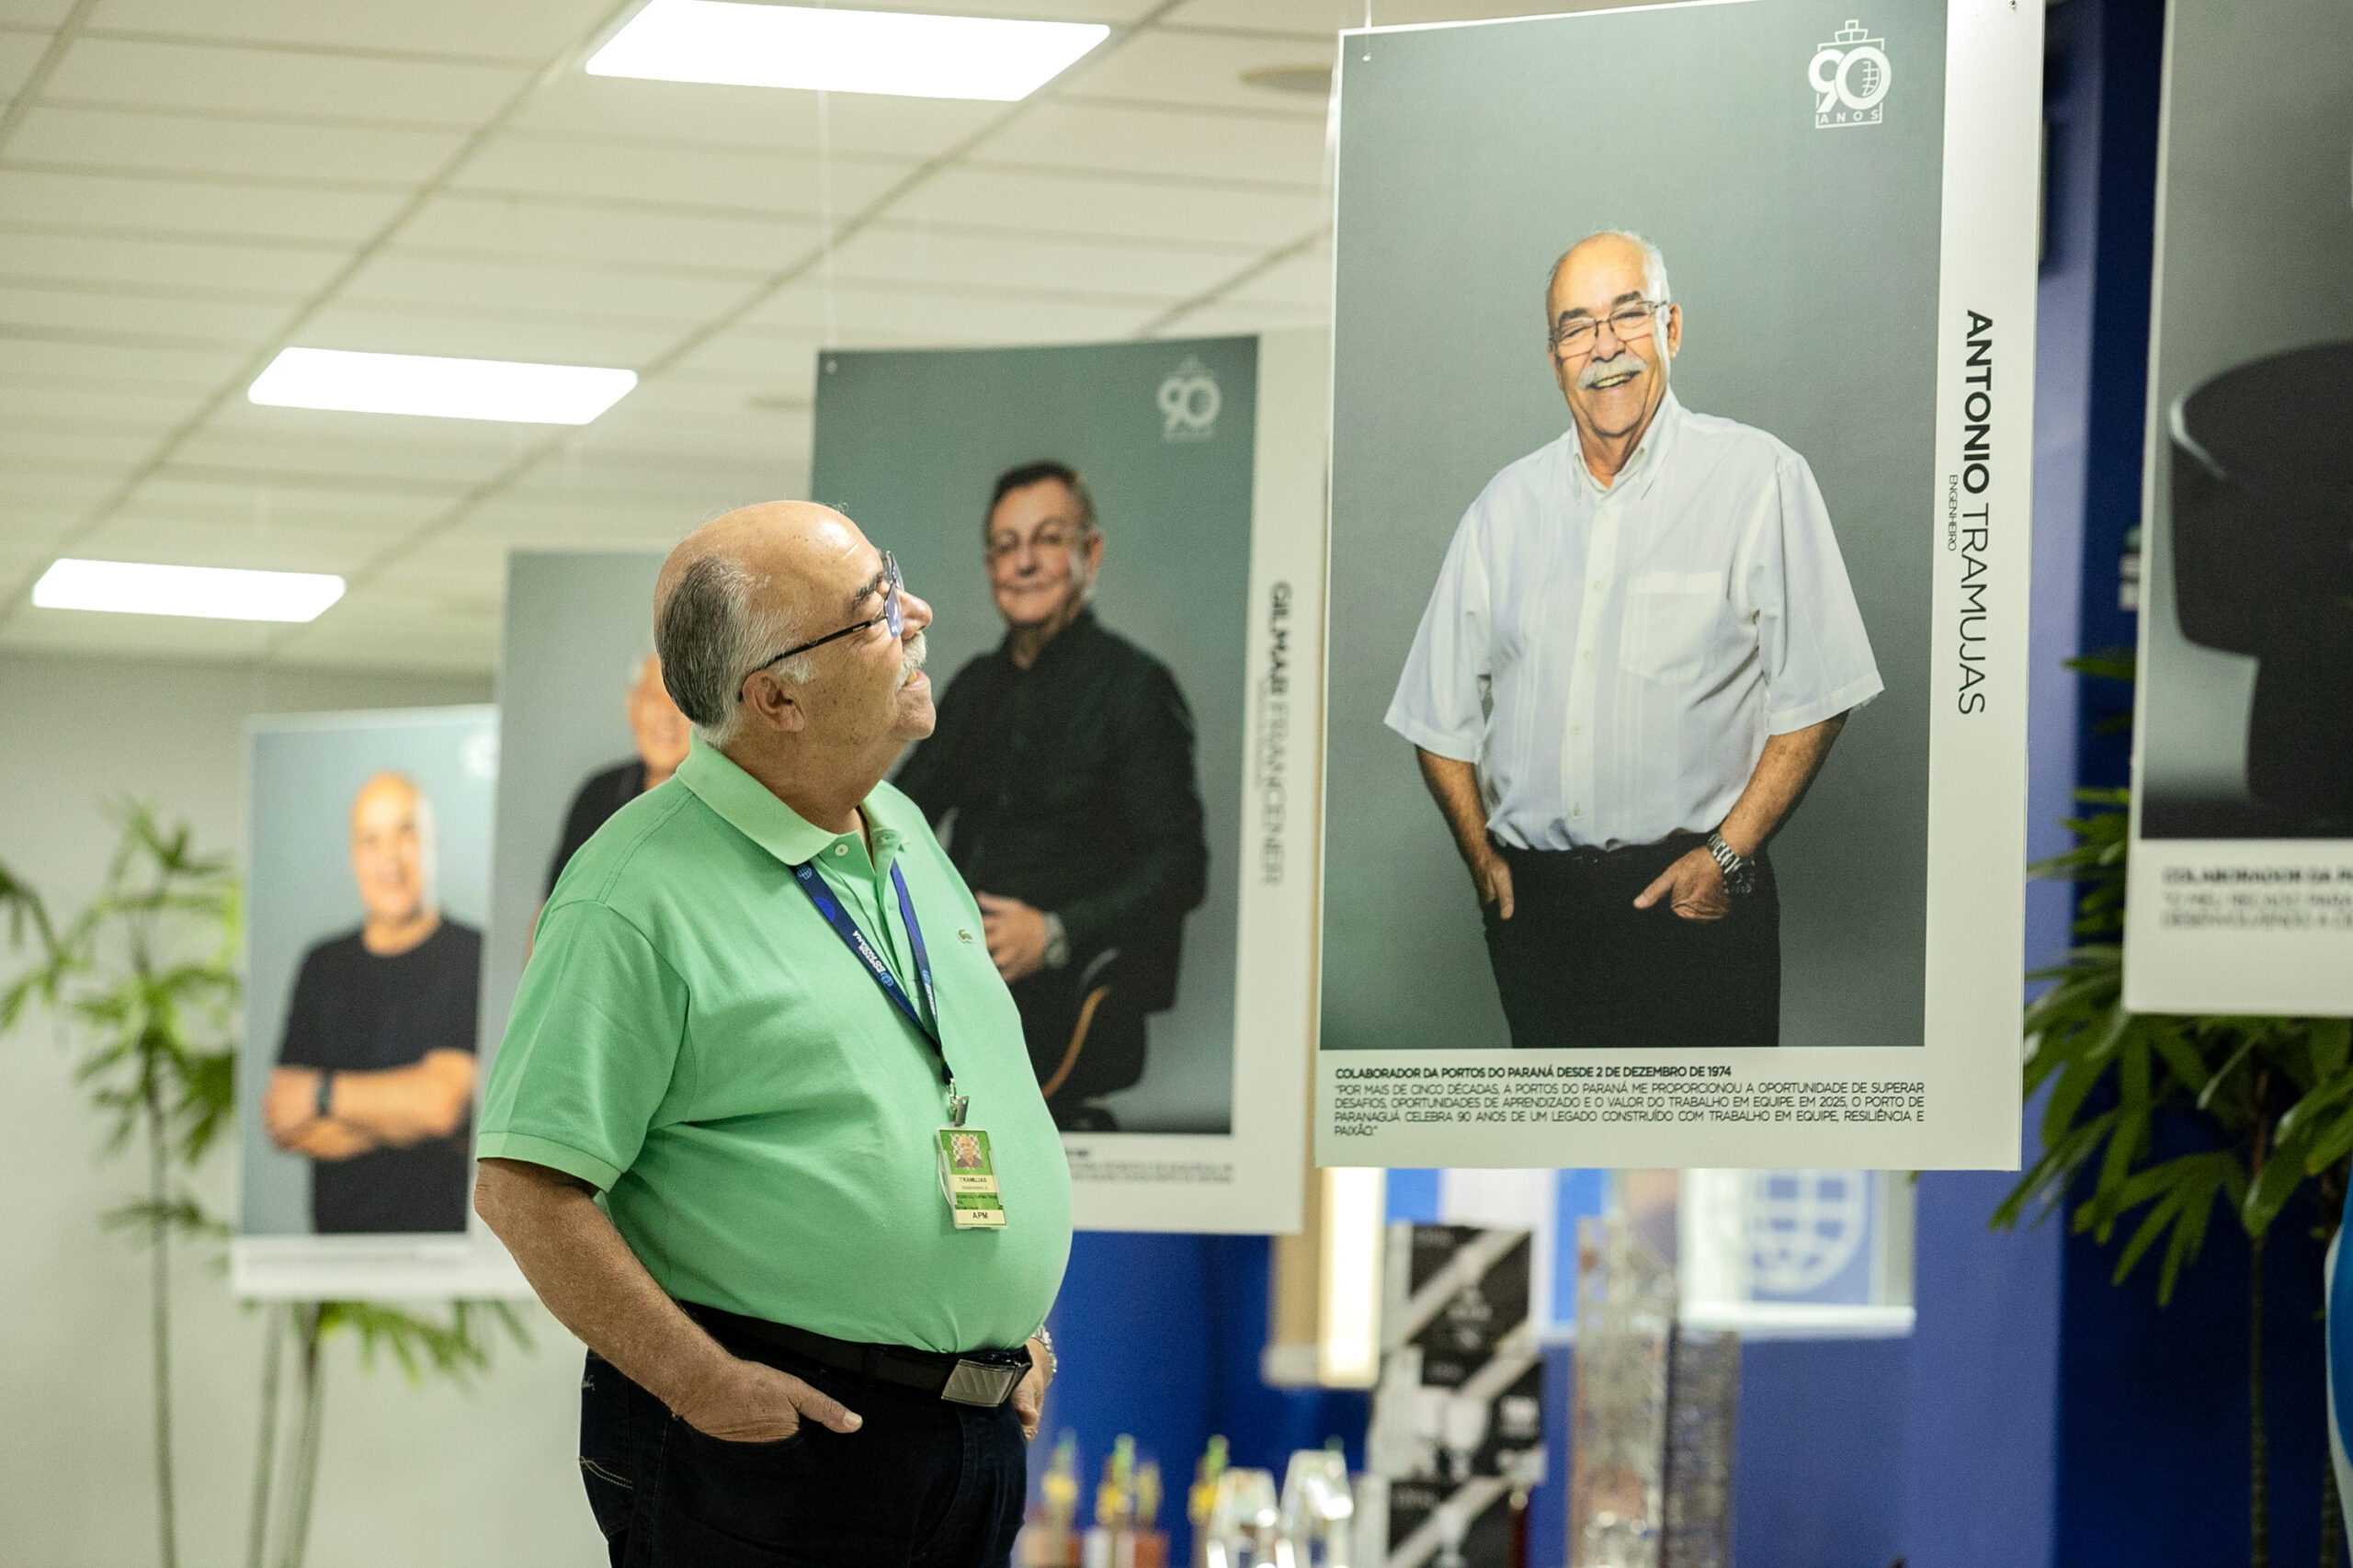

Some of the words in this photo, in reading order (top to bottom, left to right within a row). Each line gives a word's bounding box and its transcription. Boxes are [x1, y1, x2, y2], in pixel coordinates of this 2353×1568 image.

[1808, 46, 1892, 113] 90
[1819, 109, 1880, 124] ANOS
[1962, 309, 1994, 494] ANTONIO
[1948, 474, 1959, 551] ENGENHEIRO
[1958, 502, 1989, 715] TRAMUJAS
[1335, 1067, 1422, 1079] COLABORADOR
[1423, 1067, 1439, 1078] DA
[1440, 1067, 1486, 1078] PORTOS
[1487, 1066, 1506, 1078] DO
[1507, 1063, 1555, 1078] PARANÁ
[1556, 1066, 1595, 1077] DESDE
[1596, 1066, 1604, 1077] 2
[1605, 1066, 1621, 1077] DE
[1622, 1065, 1688, 1077] DEZEMBRO
[1688, 1065, 1706, 1077] DE
[1707, 1065, 1733, 1077] 1974
[1364, 1084, 1391, 1095] MAIS
[1392, 1084, 1408, 1095] DE
[1410, 1084, 1445, 1095] CINCO
[1503, 1083, 1513, 1094] A
[1515, 1083, 1560, 1094] PORTOS
[1562, 1083, 1580, 1094] DO
[1582, 1080, 1629, 1094] PARANÁ
[1631, 1083, 1649, 1094] ME
[1651, 1082, 1743, 1093] PROPORCIONOU
[1745, 1082, 1756, 1093] A
[1757, 1082, 1849, 1093] OPORTUNIDADE
[1851, 1082, 1868, 1093] DE
[1870, 1081, 1926, 1092] SUPERAR
[1391, 1096, 1482, 1108] OPORTUNIDADES
[1483, 1096, 1499, 1108] DE
[1501, 1096, 1582, 1108] APRENDIZADO
[1583, 1096, 1592, 1108] E
[1593, 1096, 1605, 1108] O
[1606, 1096, 1645, 1108] VALOR
[1646, 1096, 1666, 1108] DO
[1667, 1096, 1731, 1108] TRABALHO
[1732, 1096, 1751, 1107] EM
[1798, 1096, 1817, 1107] EM
[1818, 1096, 1849, 1108] 2025,
[1850, 1096, 1862, 1107] O
[1863, 1096, 1906, 1107] PORTO
[1907, 1096, 1926, 1107] DE
[1334, 1108, 1401, 1122] PARANAGUÁ
[1404, 1110, 1453, 1122] CELEBRA
[1457, 1110, 1472, 1122] 90
[1475, 1110, 1507, 1122] ANOS
[1510, 1110, 1526, 1122] DE
[1530, 1110, 1548, 1122] UM
[1551, 1110, 1598, 1122] LEGADO
[1601, 1108, 1675, 1122] CONSTRUÍDO
[1677, 1110, 1705, 1121] COM
[1708, 1110, 1771, 1121] TRABALHO
[1774, 1110, 1792, 1121] EM
[1795, 1110, 1840, 1123] EQUIPE,
[1843, 1107, 1913, 1121] RESILIÊNCIA
[1915, 1109, 1926, 1121] E
[972, 1211, 989, 1220] APM
